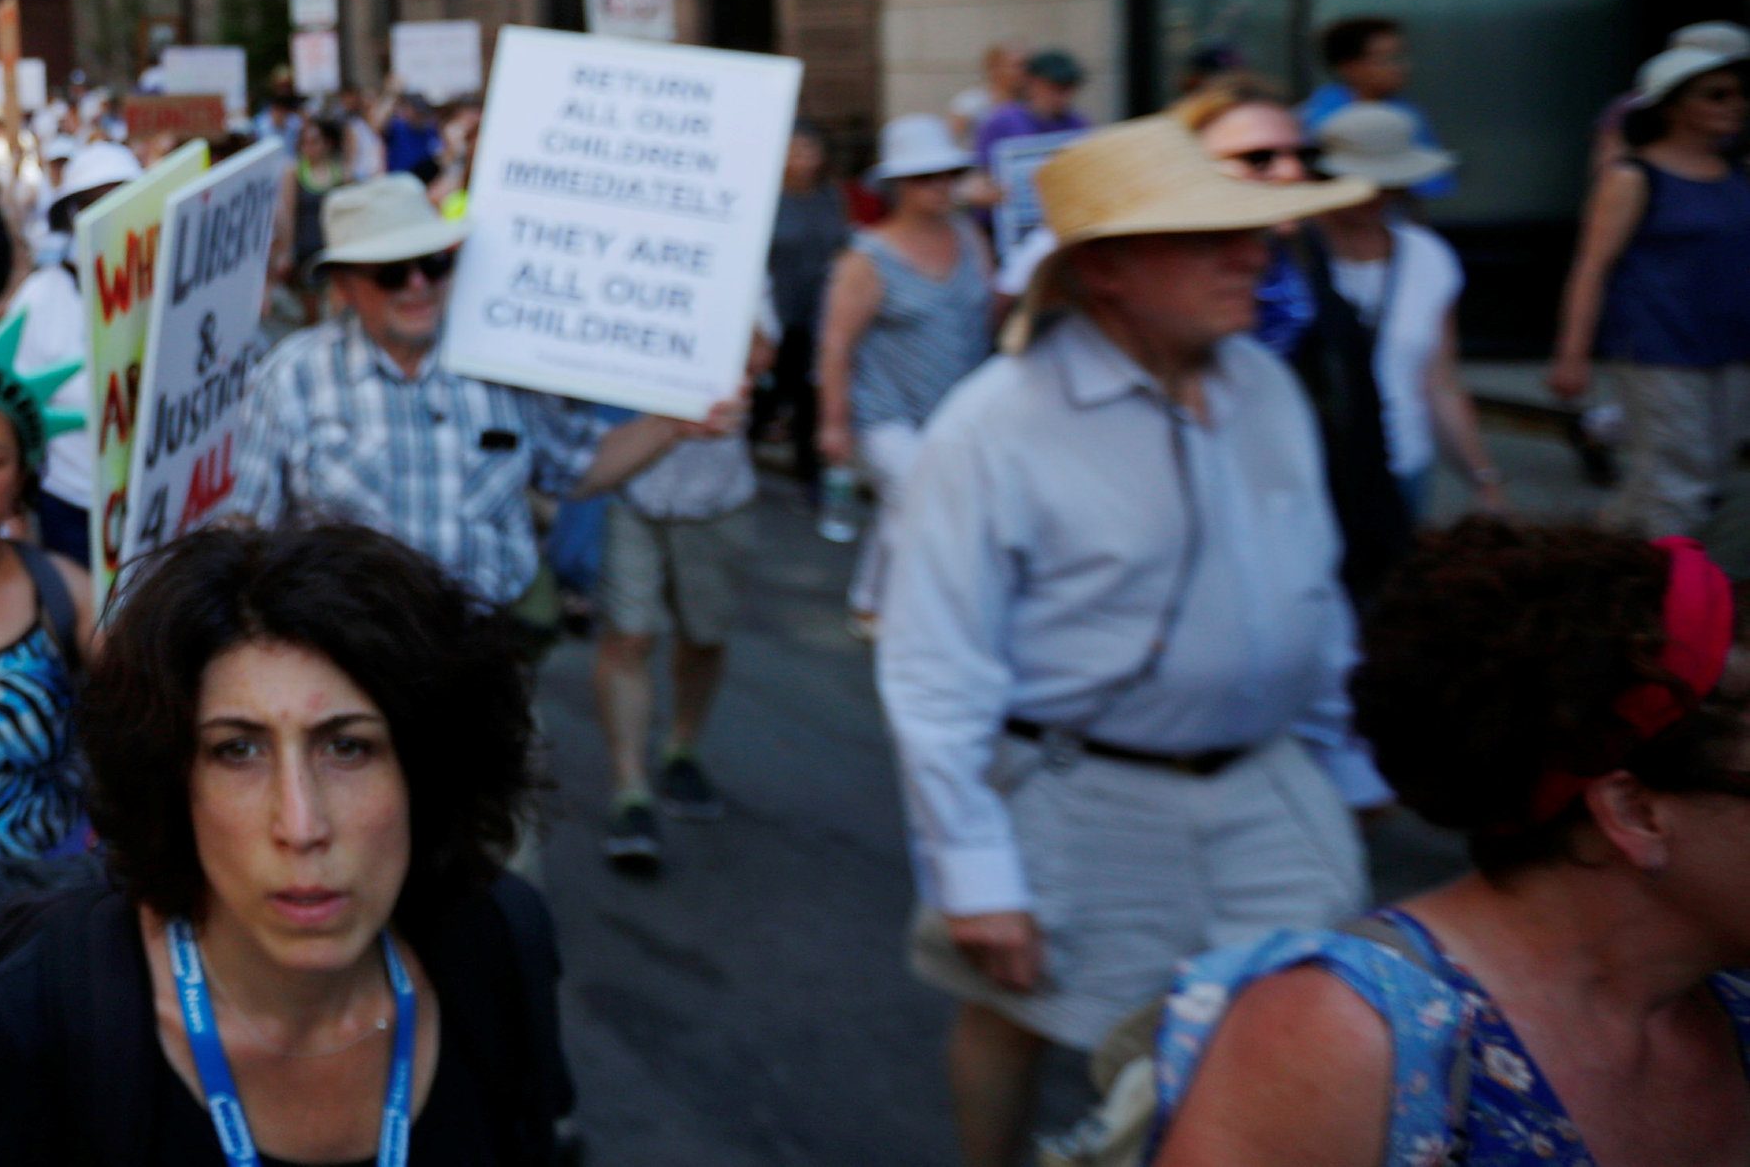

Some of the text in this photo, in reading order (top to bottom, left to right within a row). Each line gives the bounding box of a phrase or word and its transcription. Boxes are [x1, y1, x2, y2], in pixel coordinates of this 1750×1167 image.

[570, 63, 714, 103] RETURN
[559, 98, 713, 136] ALL OUR
[540, 131, 720, 174] CHILDREN
[504, 159, 741, 214] IMMEDIATELY
[511, 214, 713, 276] THEY ARE
[508, 258, 693, 314] ALL OUR
[483, 295, 697, 359] CHILDREN
[176, 430, 237, 537] ALL
